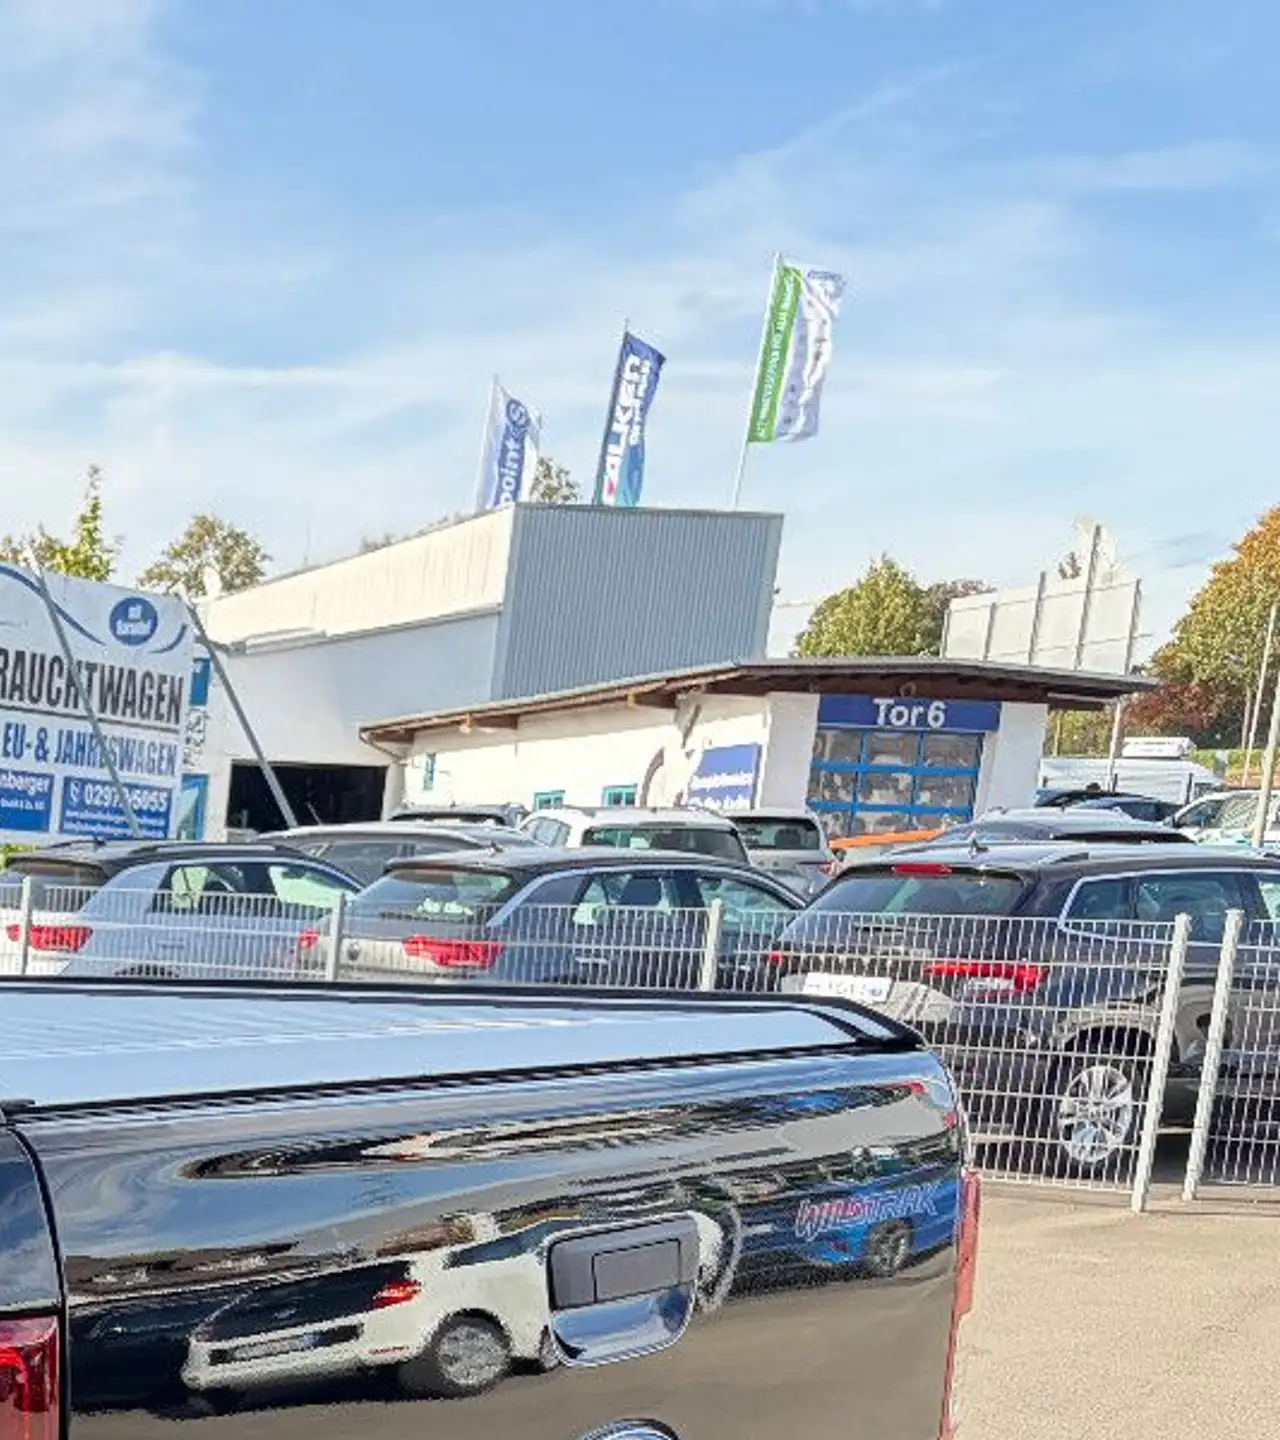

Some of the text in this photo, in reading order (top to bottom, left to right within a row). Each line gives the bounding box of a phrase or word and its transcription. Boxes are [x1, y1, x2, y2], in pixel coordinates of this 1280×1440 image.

[873, 698, 946, 728] Tor 6
[1, 721, 34, 761] EU-
[35, 731, 51, 765] &
